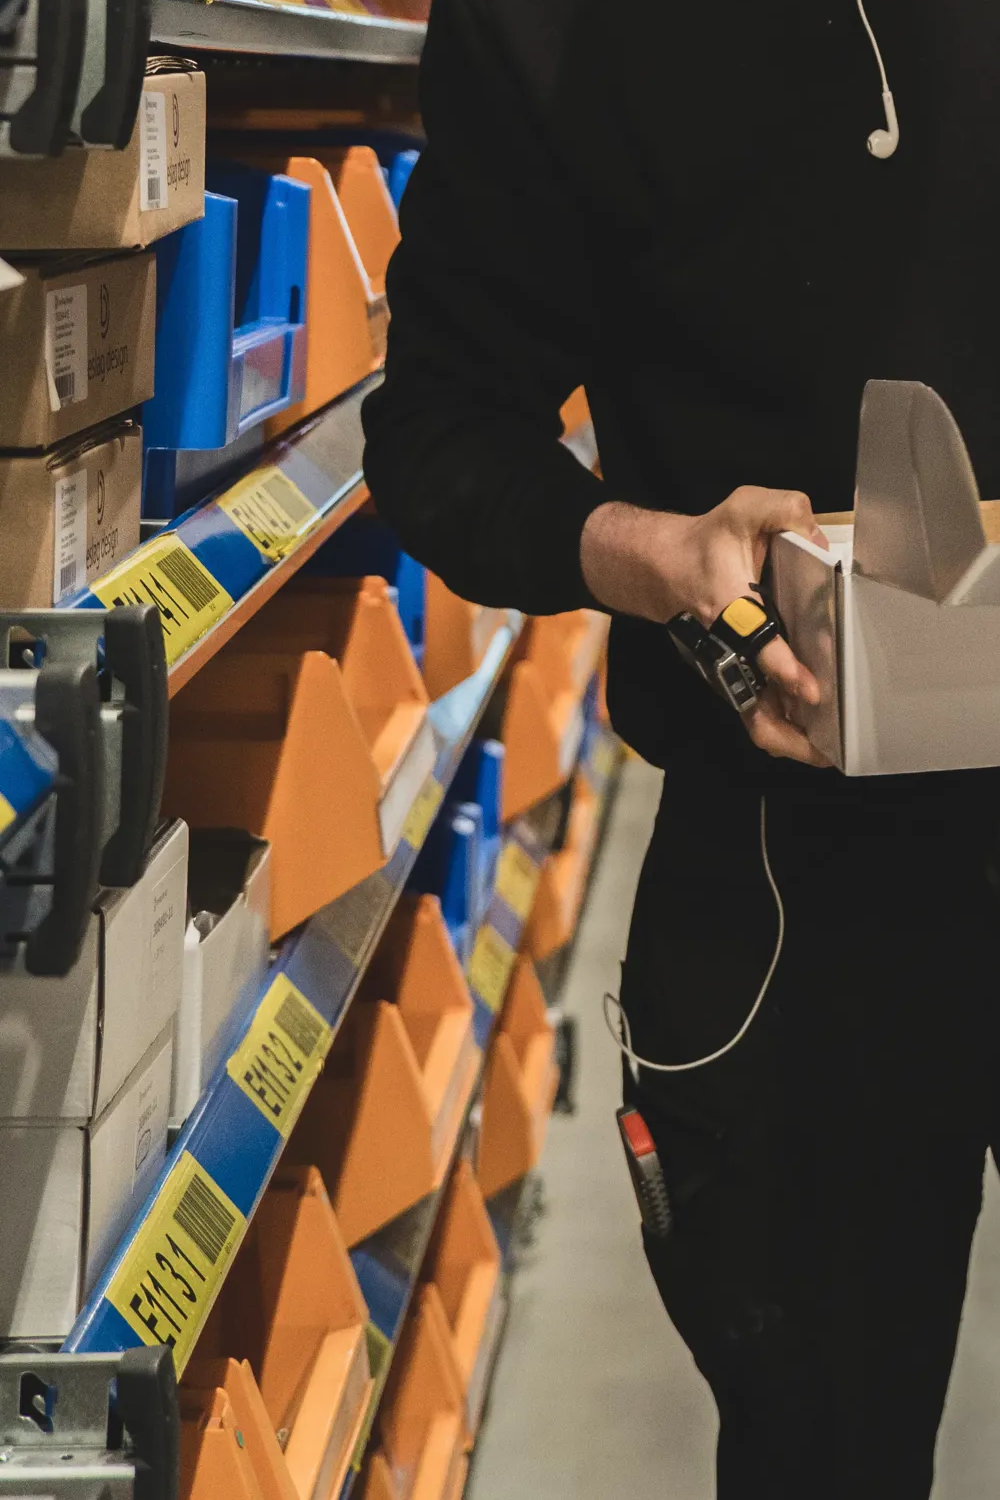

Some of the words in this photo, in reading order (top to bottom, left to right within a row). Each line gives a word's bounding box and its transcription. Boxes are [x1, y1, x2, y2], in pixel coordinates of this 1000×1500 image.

[87, 348, 105, 382] eslag
[106, 342, 128, 374] design
[86, 534, 100, 570] eslag
[100, 525, 119, 558] design
[243, 1031, 303, 1117] E1132
[129, 1233, 206, 1350] E1131
